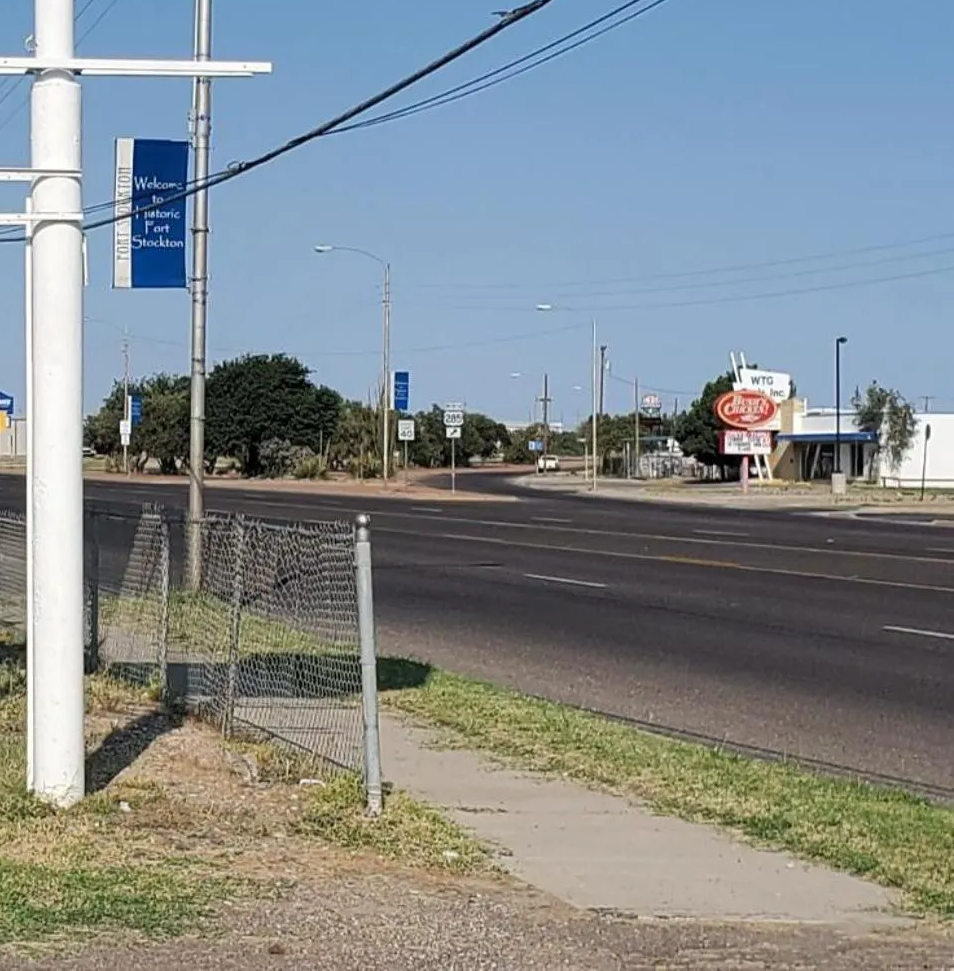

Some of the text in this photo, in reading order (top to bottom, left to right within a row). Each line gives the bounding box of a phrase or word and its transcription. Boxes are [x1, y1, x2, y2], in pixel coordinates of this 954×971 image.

[152, 195, 164, 204] to
[131, 234, 184, 249] Stockton
[751, 376, 774, 386] WTG
[445, 414, 462, 424] 285
